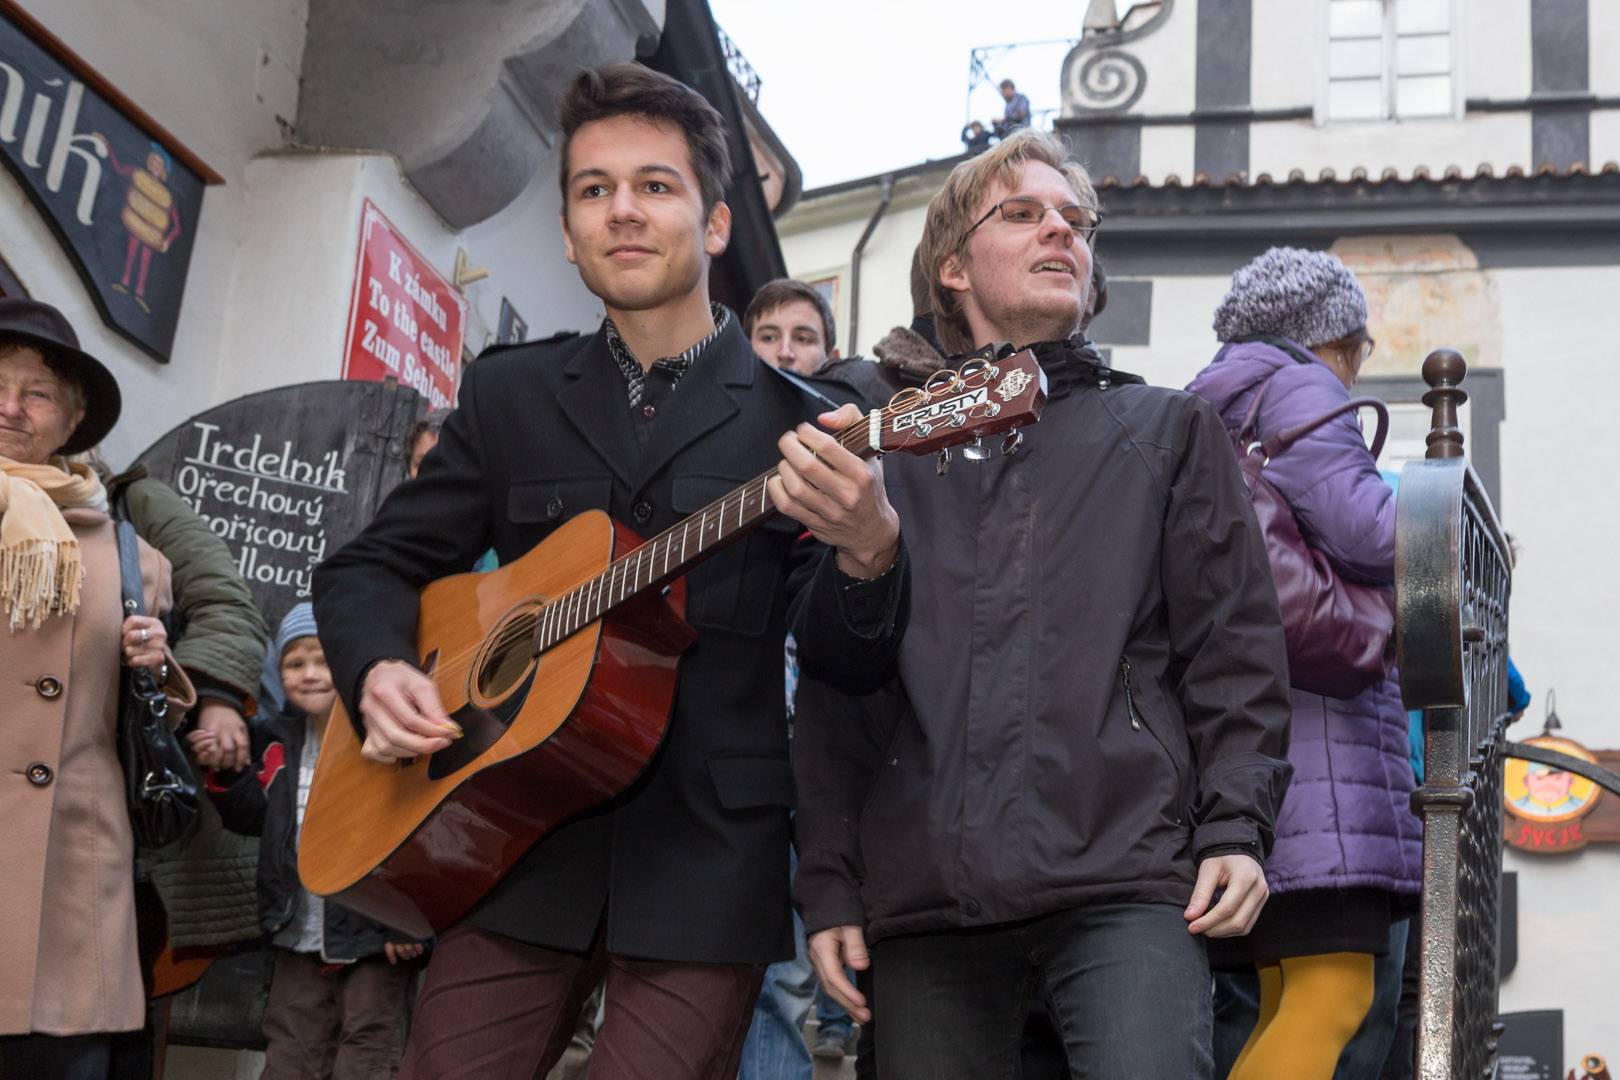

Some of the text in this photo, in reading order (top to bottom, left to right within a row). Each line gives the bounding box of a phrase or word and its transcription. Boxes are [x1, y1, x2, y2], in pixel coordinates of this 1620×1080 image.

[389, 250, 447, 332] K zámku
[362, 320, 400, 372] Zum
[369, 277, 455, 382] To the castle
[190, 422, 346, 491] Trdelník
[178, 465, 323, 525] Ořechový
